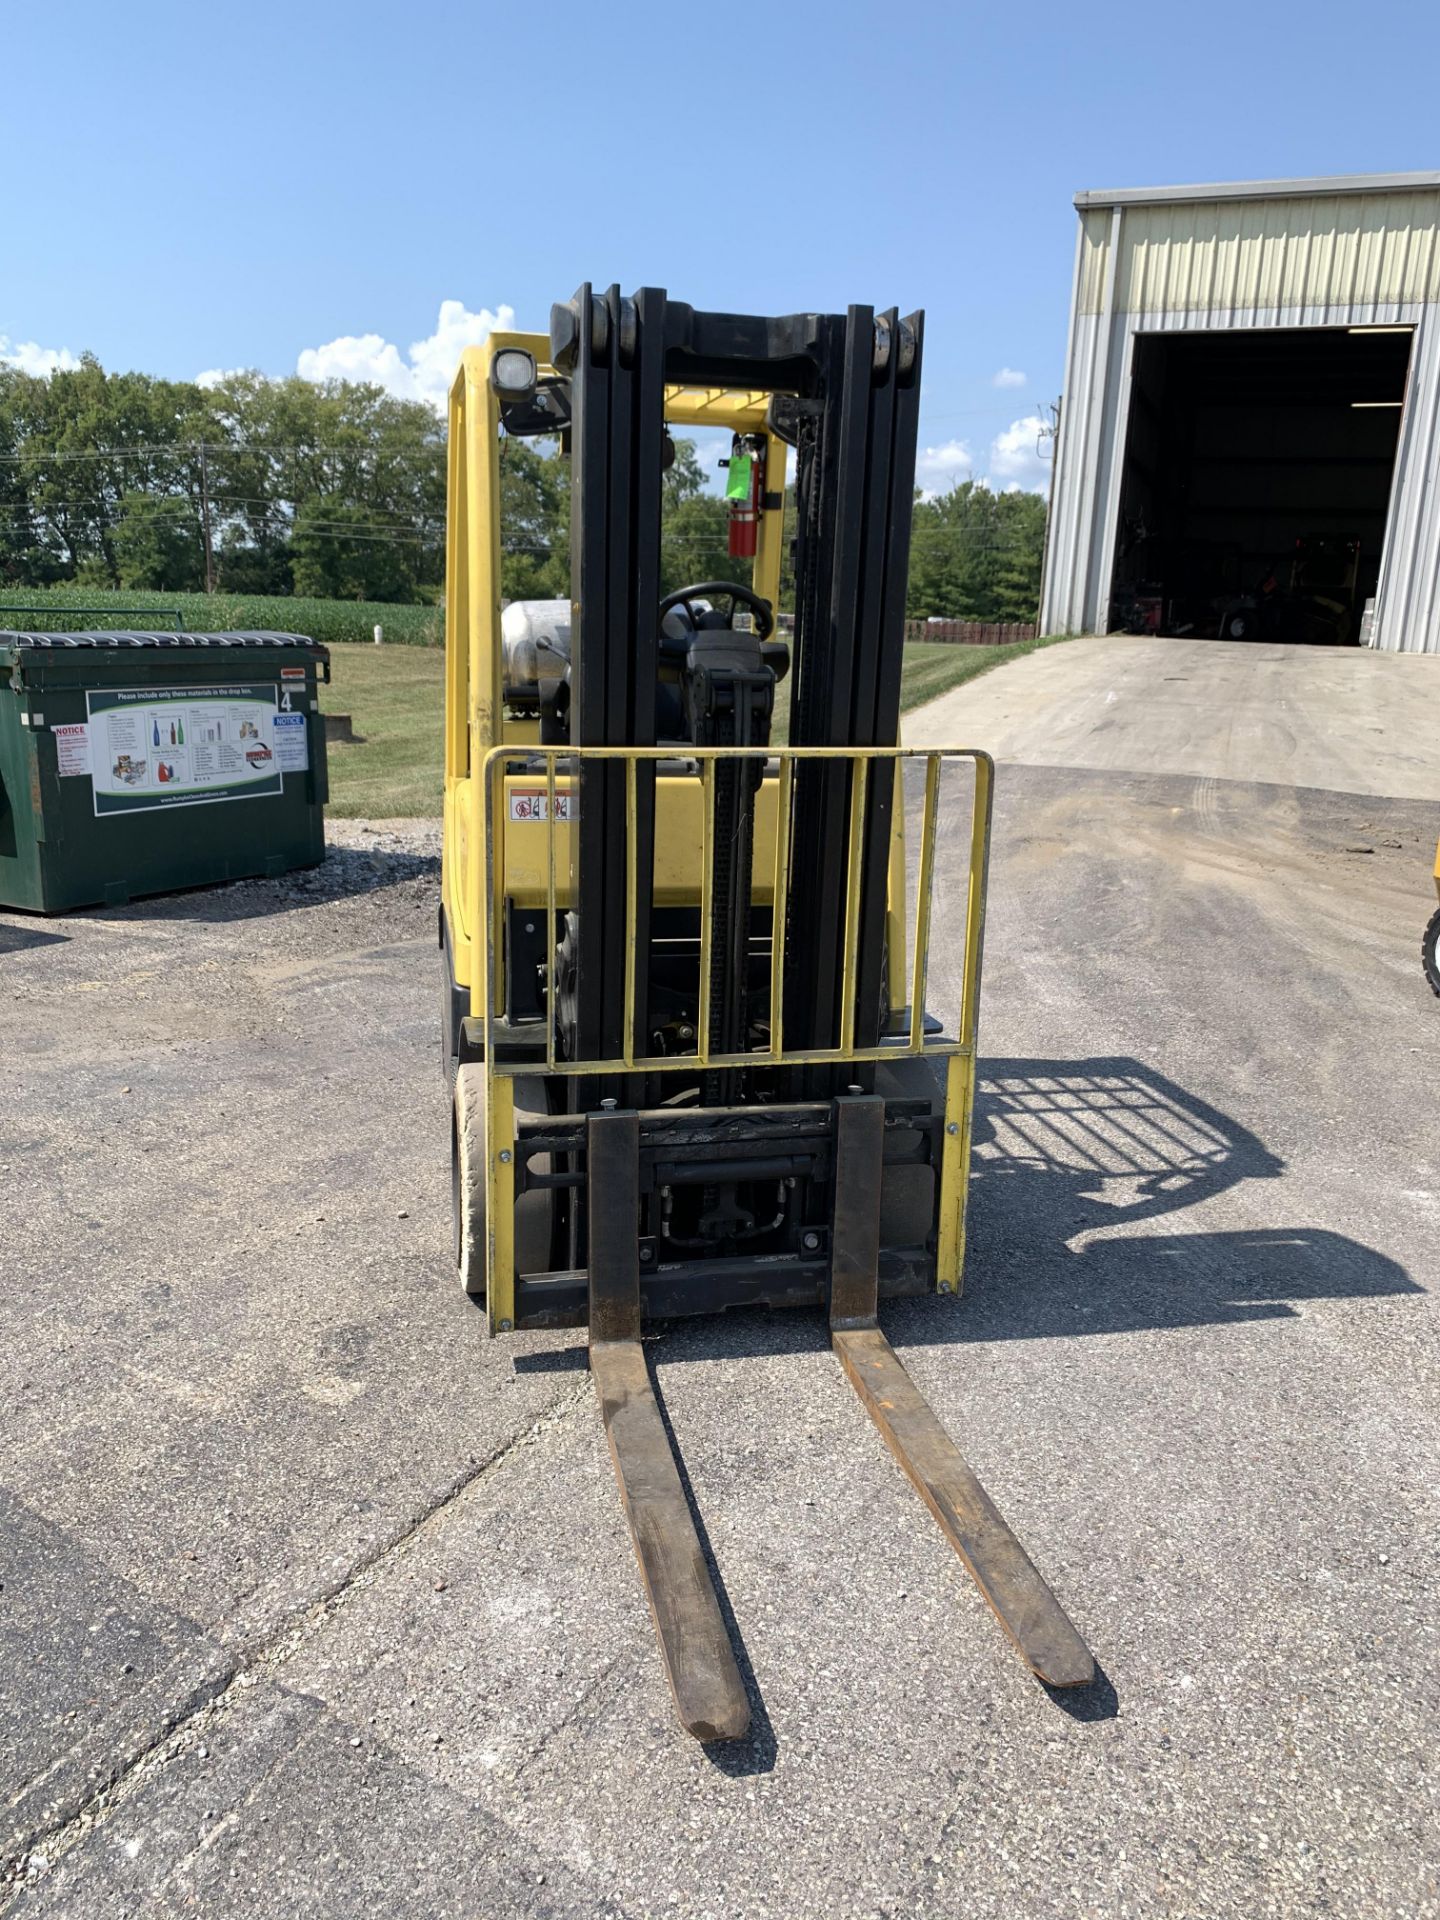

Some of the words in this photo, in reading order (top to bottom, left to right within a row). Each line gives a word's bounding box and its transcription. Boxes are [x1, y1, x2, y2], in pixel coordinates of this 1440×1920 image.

[117, 692, 136, 700] Please
[137, 691, 158, 699] include
[158, 690, 171, 699] only
[171, 690, 187, 698] these
[187, 689, 212, 697] materials
[281, 692, 292, 712] 4
[276, 717, 301, 725] NOTICE
[56, 726, 85, 736] NOTICE
